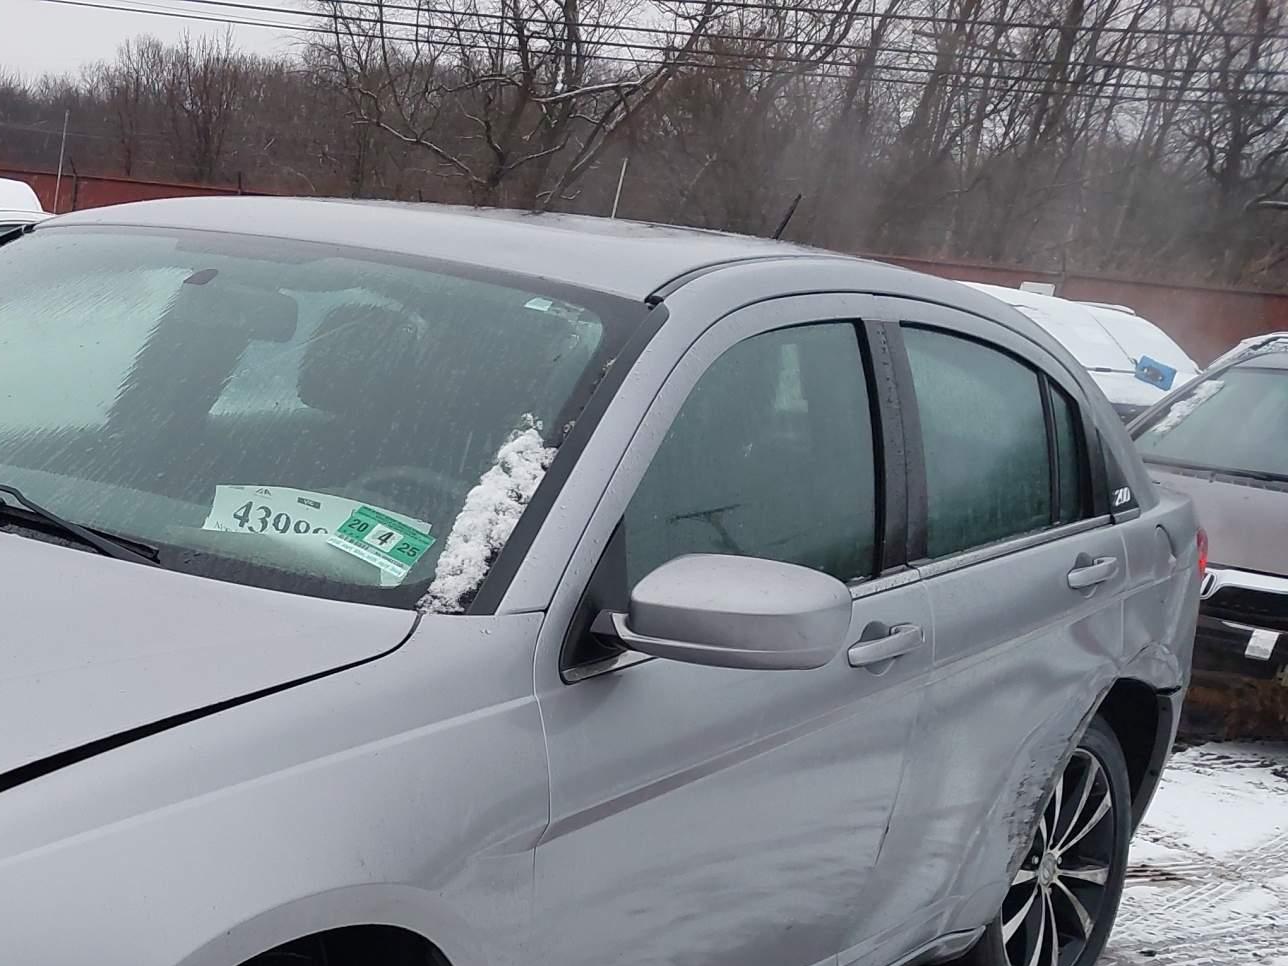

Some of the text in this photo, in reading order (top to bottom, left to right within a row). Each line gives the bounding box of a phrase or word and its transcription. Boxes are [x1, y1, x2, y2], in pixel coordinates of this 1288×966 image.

[348, 518, 369, 533] 20
[376, 531, 395, 546] 4
[397, 542, 420, 557] 25
